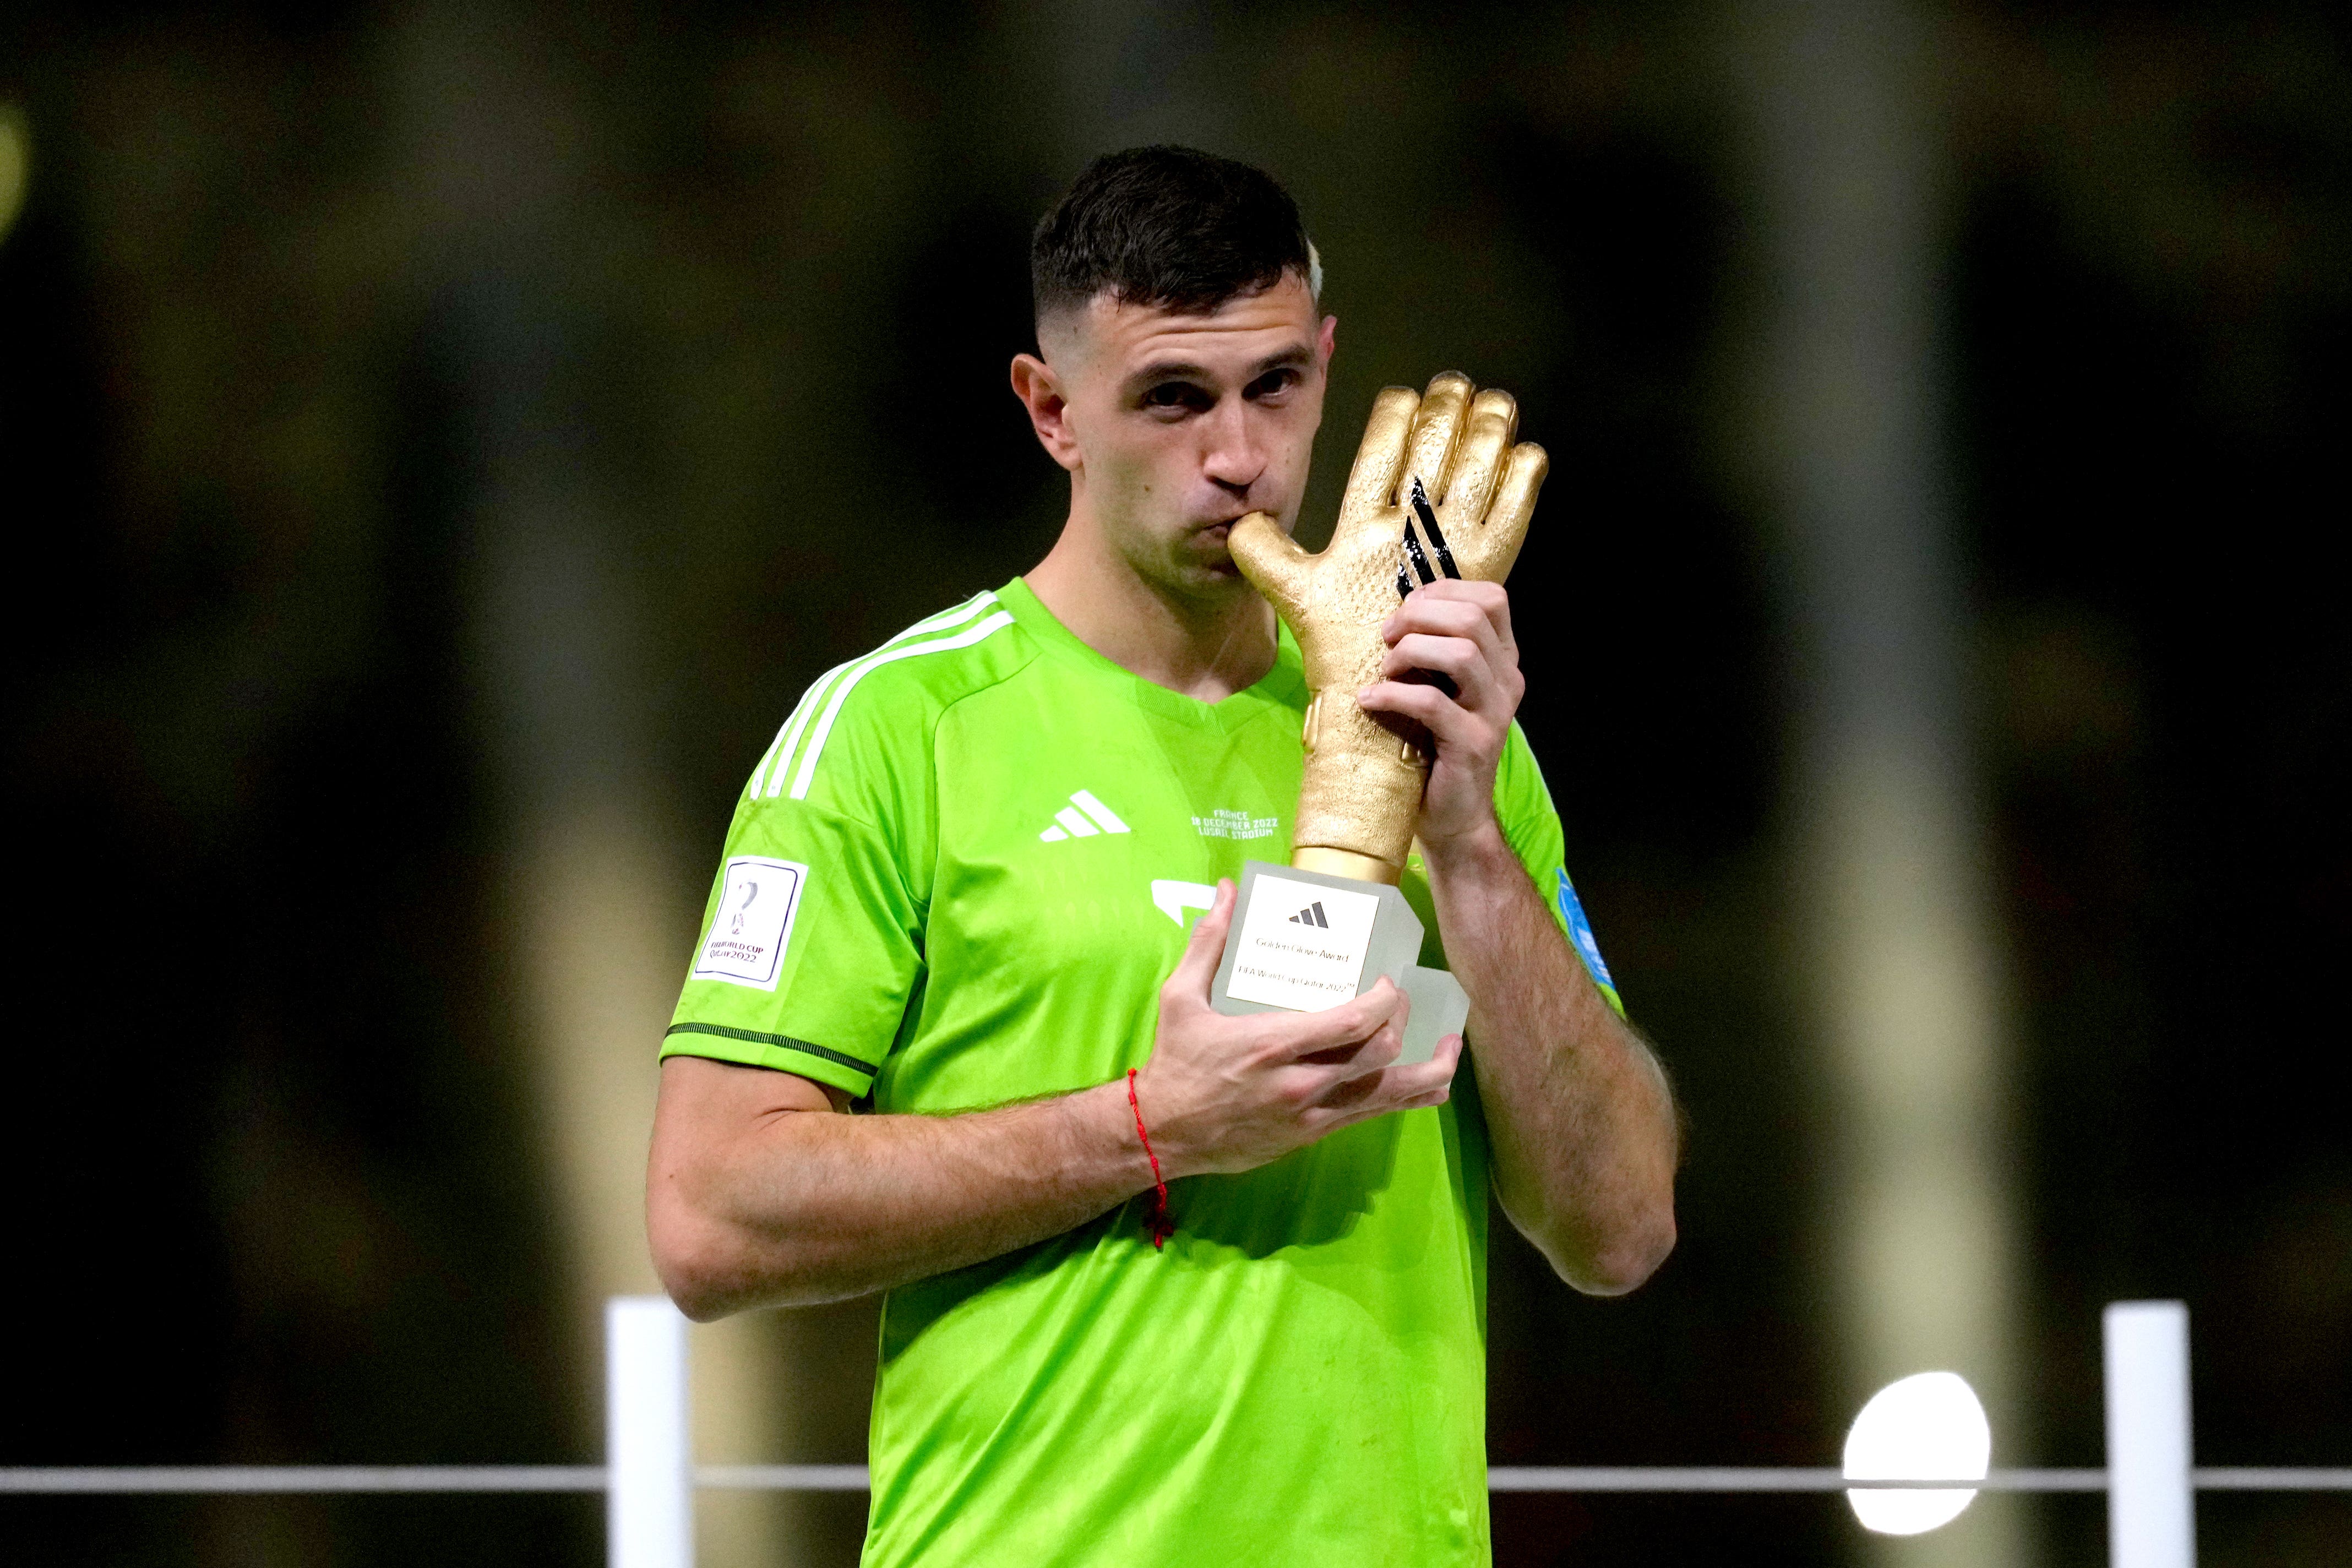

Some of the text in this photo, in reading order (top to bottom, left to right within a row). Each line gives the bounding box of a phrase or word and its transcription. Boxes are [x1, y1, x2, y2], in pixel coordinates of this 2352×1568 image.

[1214, 810, 1248, 820] FRANCE
[1204, 819, 1250, 830] DECEMBER
[1253, 818, 1277, 828] 2022
[1199, 826, 1272, 839] LUSAIL STADIUM
[721, 941, 745, 950] WORLD
[746, 945, 764, 954] CUP
[1256, 938, 1349, 962] Golden Glove Award
[731, 950, 756, 963] 2022
[1239, 966, 1255, 975] FIFA
[1257, 969, 1281, 981] World
[1300, 977, 1325, 989] Qatar
